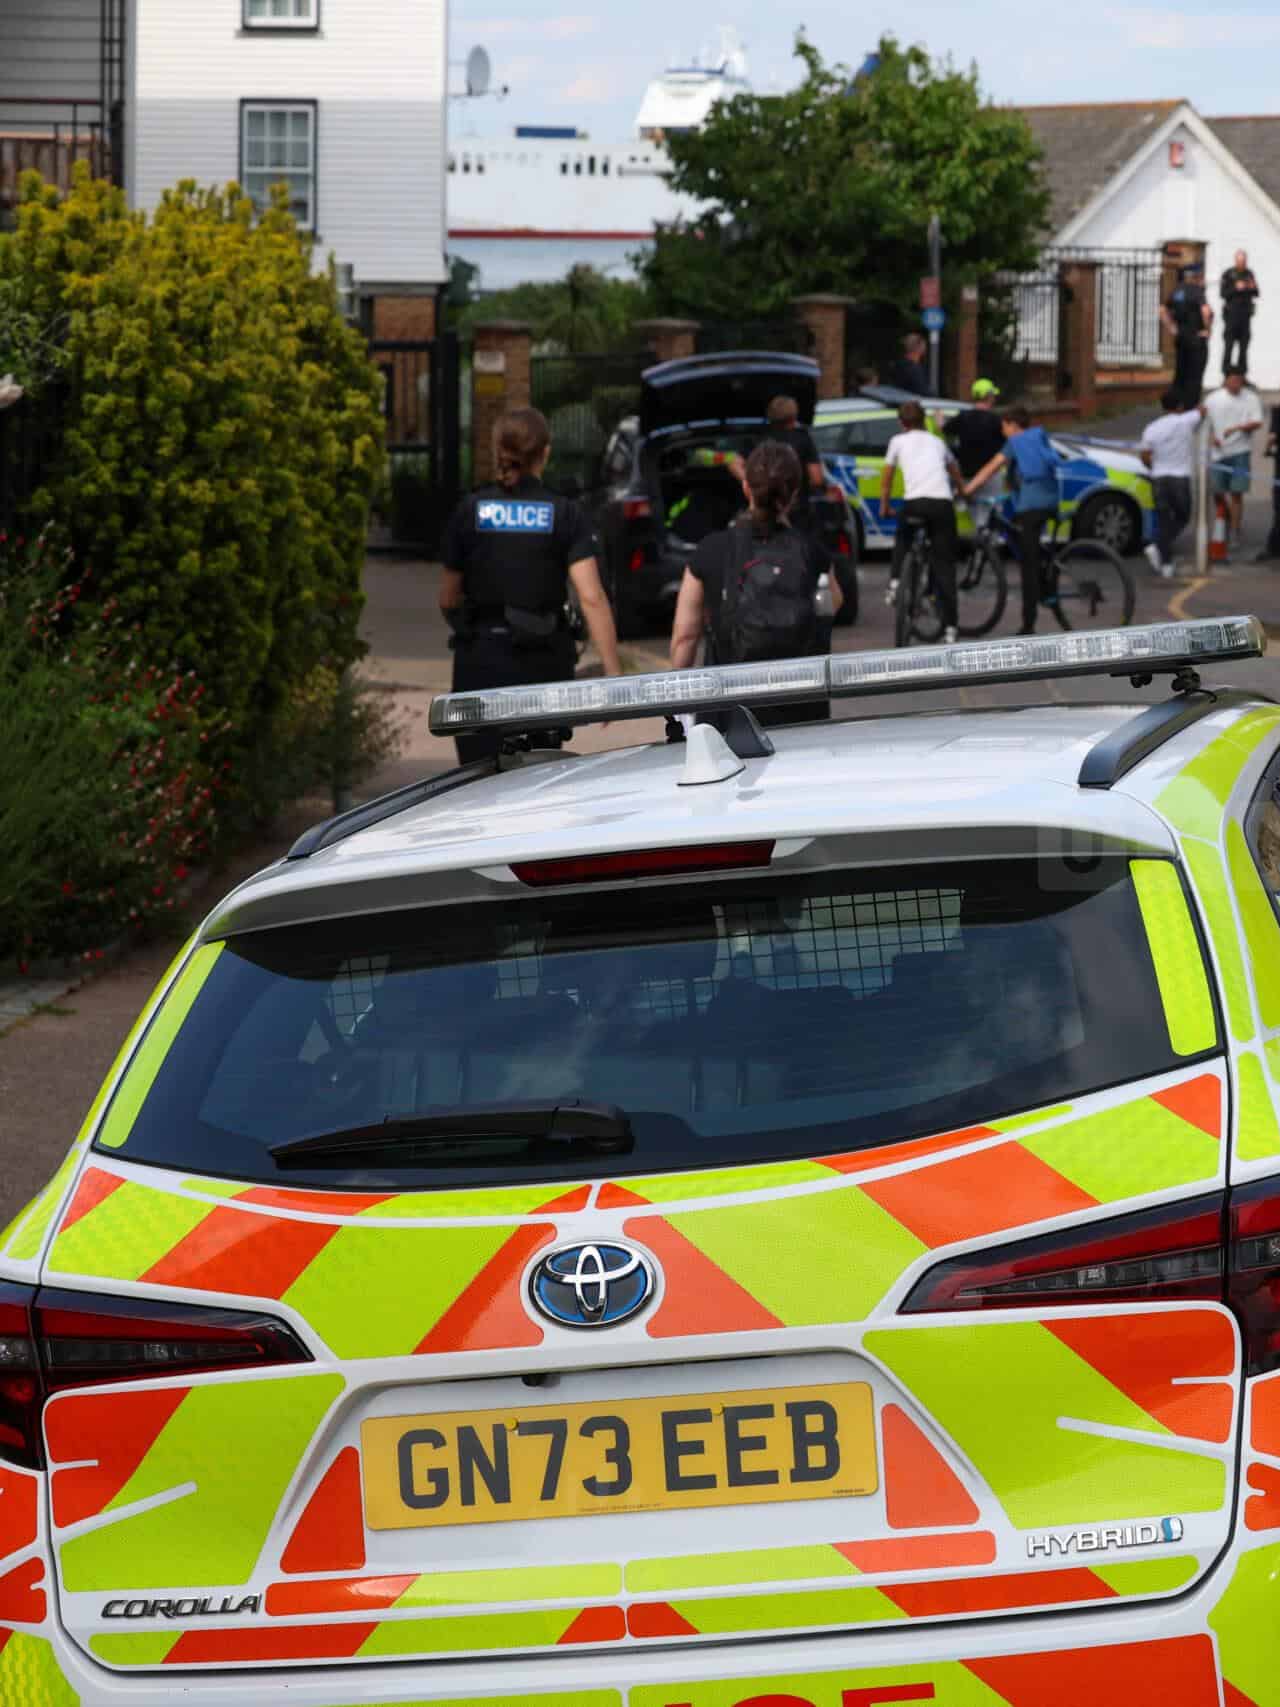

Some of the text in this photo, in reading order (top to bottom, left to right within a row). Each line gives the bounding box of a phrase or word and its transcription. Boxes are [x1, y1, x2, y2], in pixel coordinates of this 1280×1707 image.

[478, 503, 549, 527] POLICE
[397, 1400, 841, 1510] GN73 EEB
[1028, 1525, 1158, 1557] HYBRID
[101, 1593, 262, 1618] COROLLA
